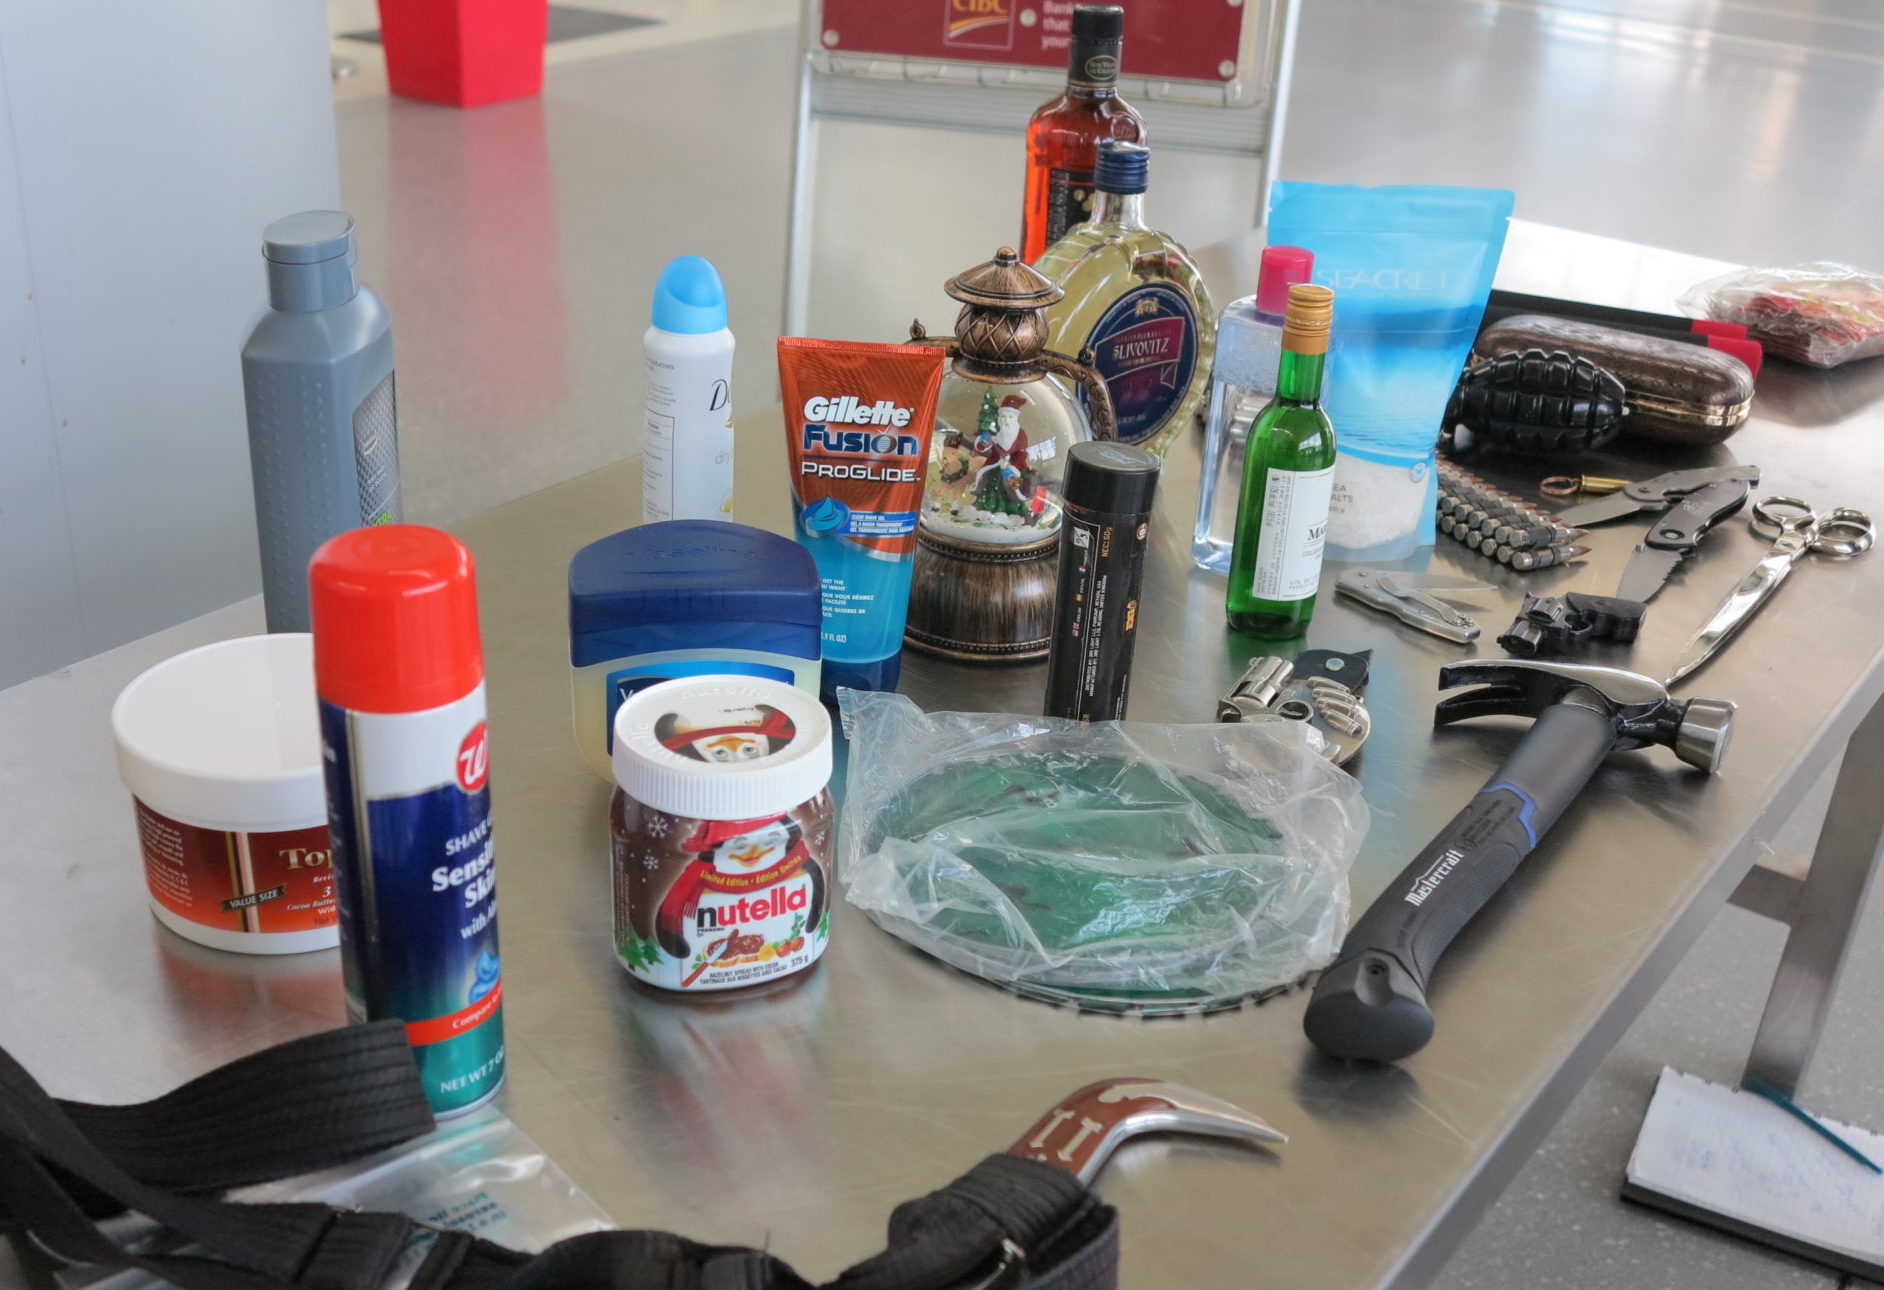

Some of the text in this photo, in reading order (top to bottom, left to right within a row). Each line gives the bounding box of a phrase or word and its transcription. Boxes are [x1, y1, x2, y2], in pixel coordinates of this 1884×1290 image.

[1317, 269, 1450, 290] SEACRET
[803, 396, 912, 427] Gillette
[804, 423, 920, 455] Fusion
[445, 818, 487, 856] SHAVE
[700, 869, 726, 885] Limited
[1403, 849, 1465, 907] Mastercraft
[229, 888, 279, 909] VALUE SIZE
[696, 884, 807, 928] nutella
[790, 956, 803, 968] 375
[452, 1001, 492, 1029] Compare
[440, 1075, 466, 1094] NET
[467, 1063, 488, 1083] WT
